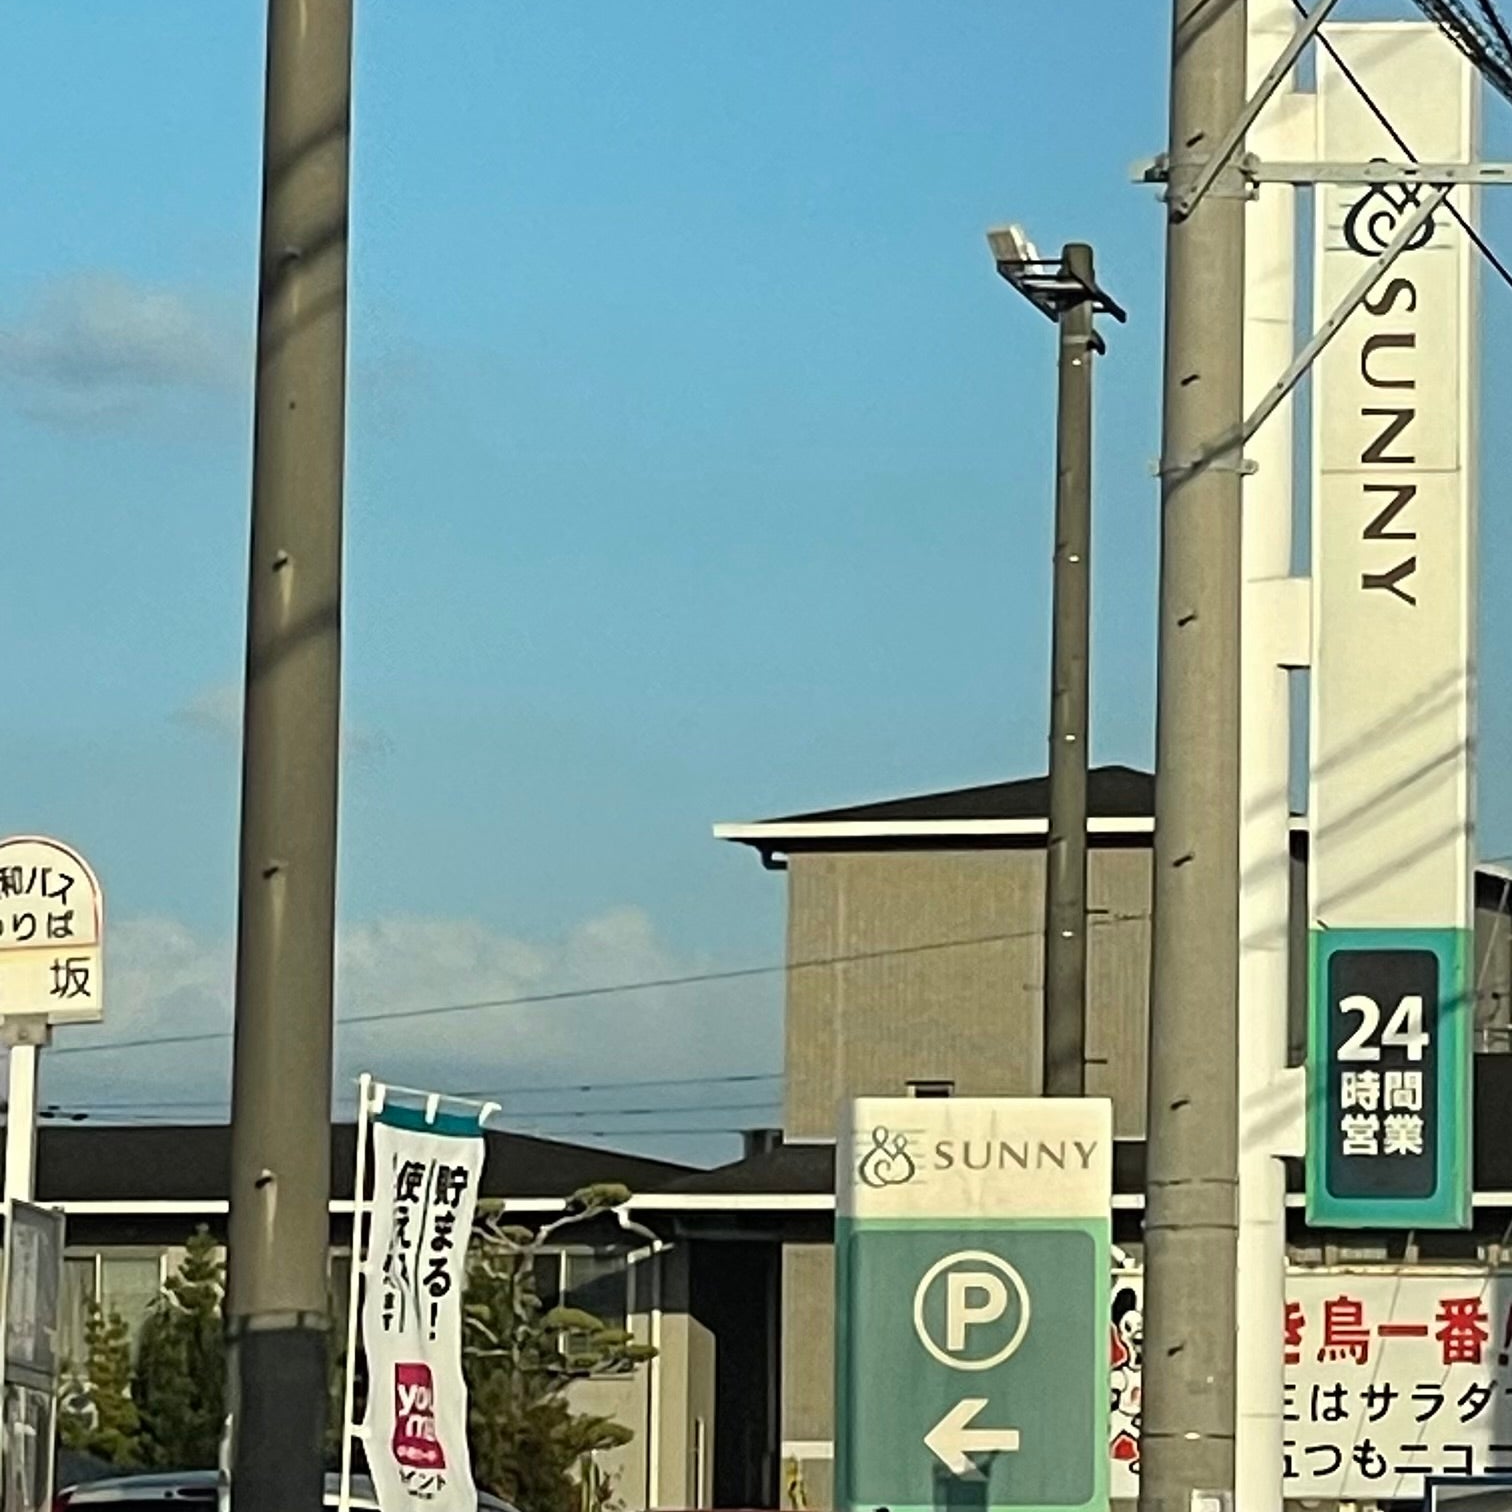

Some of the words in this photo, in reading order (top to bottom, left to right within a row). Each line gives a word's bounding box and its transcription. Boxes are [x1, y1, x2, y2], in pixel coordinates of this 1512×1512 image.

[1361, 277, 1417, 606] SUNNY
[50, 957, 91, 999] 坂
[1337, 995, 1430, 1061] 24
[1341, 1070, 1423, 1111] 時間
[934, 1140, 1098, 1170] SUNNY
[1341, 1113, 1424, 1155] 営業
[946, 1272, 1009, 1351] P
